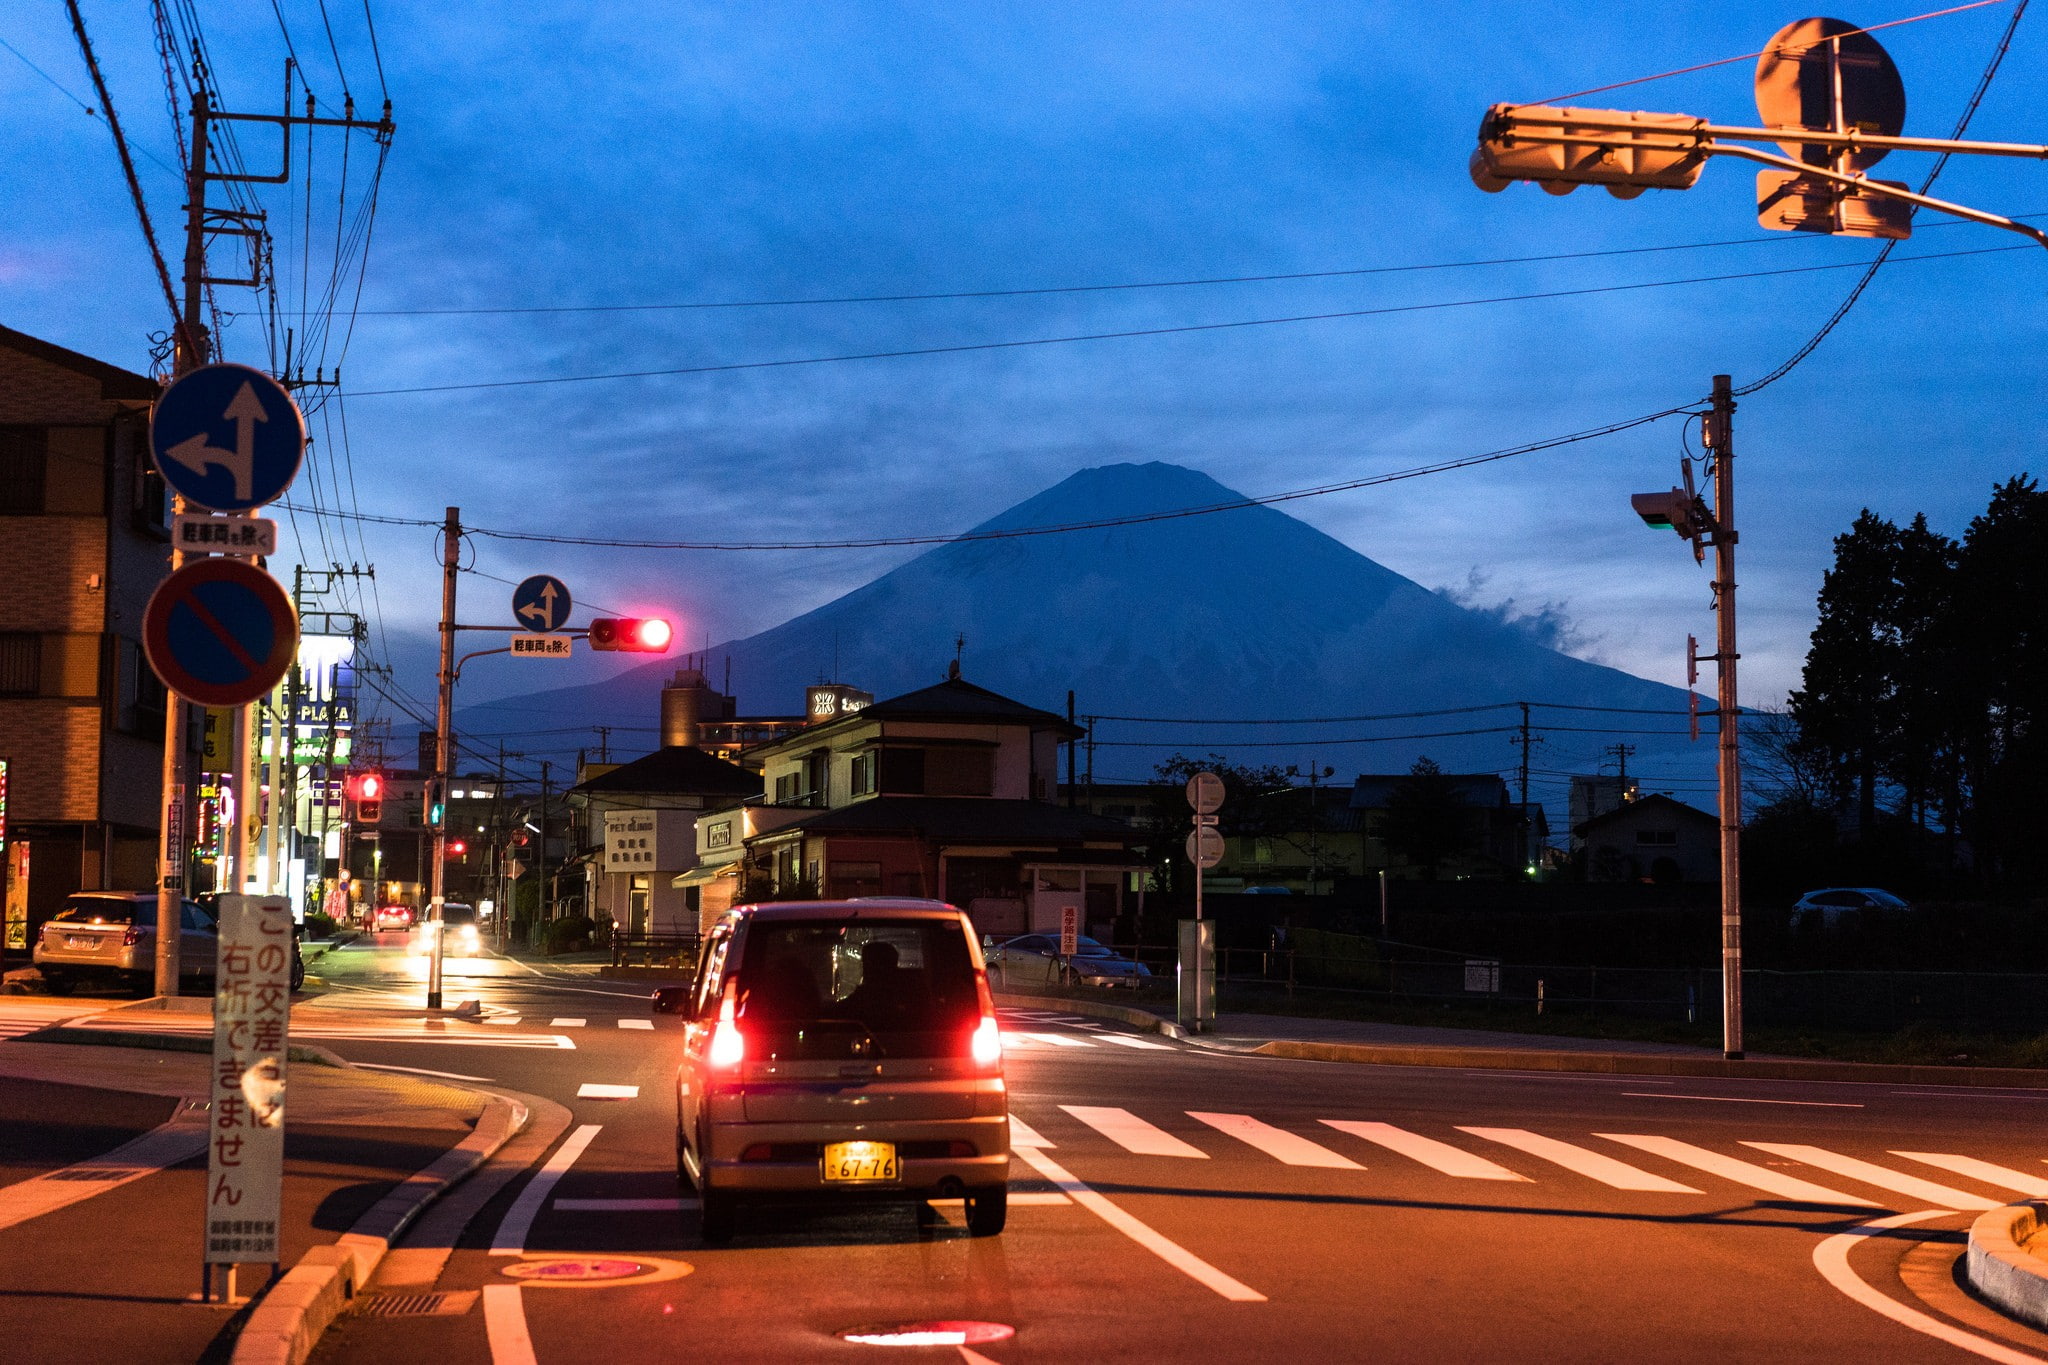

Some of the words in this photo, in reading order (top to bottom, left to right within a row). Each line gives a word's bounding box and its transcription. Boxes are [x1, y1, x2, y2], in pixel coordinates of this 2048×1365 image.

[183, 523, 267, 546] 軽車両を除く
[514, 639, 568, 653] 軽車両を除く
[609, 823, 625, 833] PET
[212, 939, 253, 1206] 右折できません
[840, 1158, 893, 1177] 67-76
